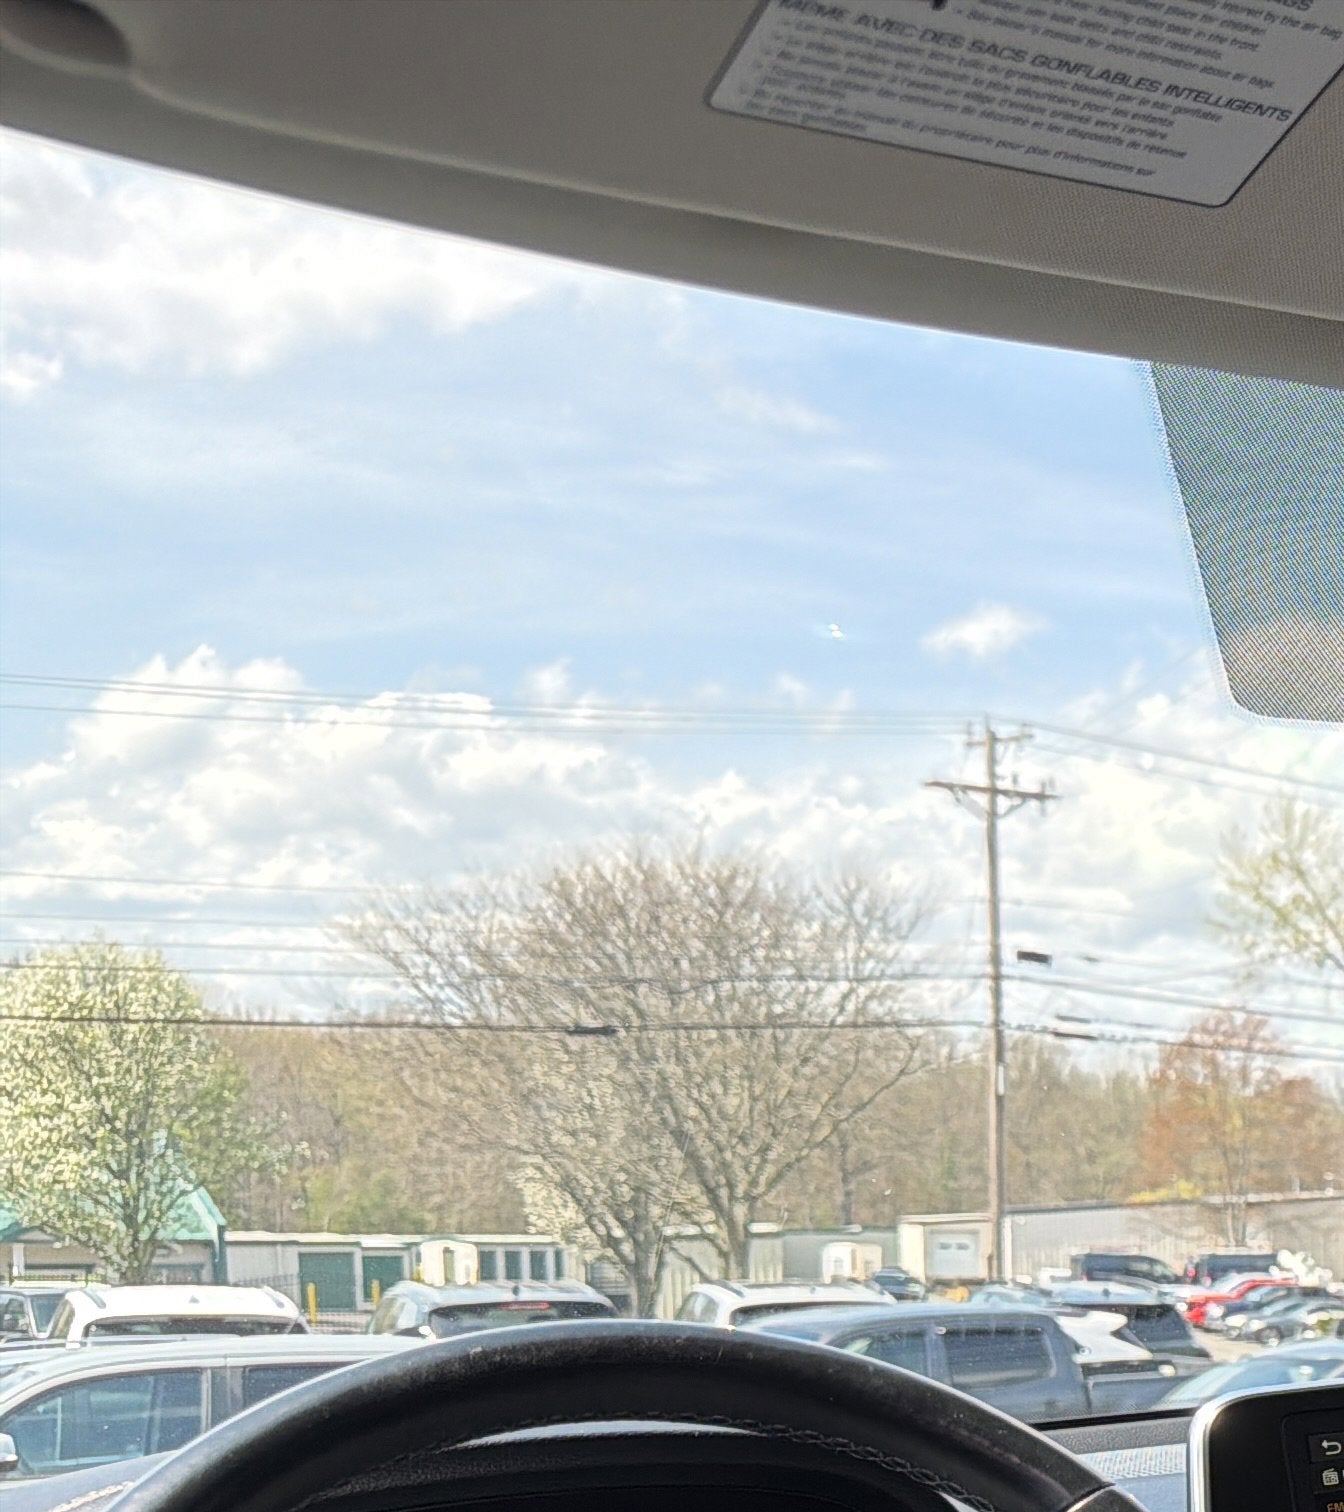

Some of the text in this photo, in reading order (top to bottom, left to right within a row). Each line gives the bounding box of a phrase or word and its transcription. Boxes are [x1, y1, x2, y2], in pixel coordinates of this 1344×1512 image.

[967, 39, 1029, 63] SACS
[1029, 53, 1164, 94] GONFLABLES
[1163, 83, 1293, 123] INTELLIGENTS
